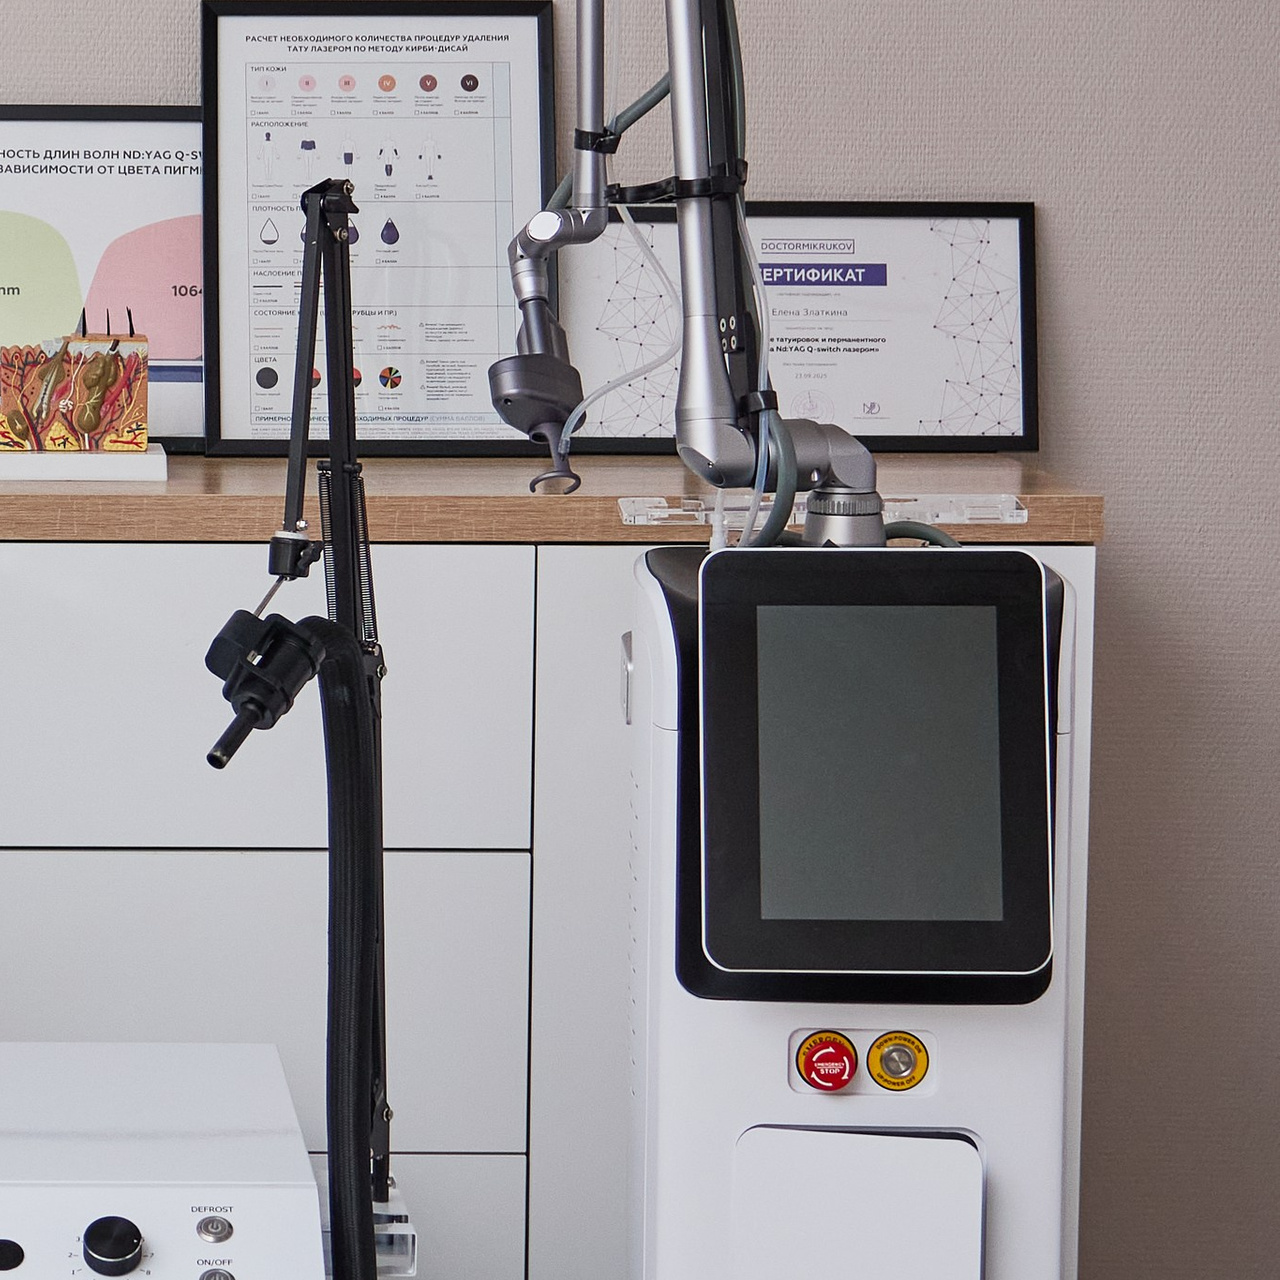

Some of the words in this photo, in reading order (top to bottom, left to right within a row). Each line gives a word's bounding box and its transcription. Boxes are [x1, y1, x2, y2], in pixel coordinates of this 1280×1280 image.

[280, 35, 353, 43] НЕОБХОДИМОГО
[414, 35, 461, 43] ПРОЦЕДУР
[462, 35, 510, 43] УДАЛЕНИЯ
[368, 45, 403, 53] МЕТОДУ
[43, 149, 80, 160] ДЛИН
[83, 150, 120, 159] ВОЛН
[123, 150, 171, 159] ND:YAG
[97, 165, 115, 174] ОТ
[118, 166, 160, 176] ЦВЕТА
[164, 166, 202, 175] ПИГМ
[761, 242, 853, 251] DOCTORMIKRUKOV
[772, 308, 800, 316] Елена
[803, 308, 848, 316] Златкина
